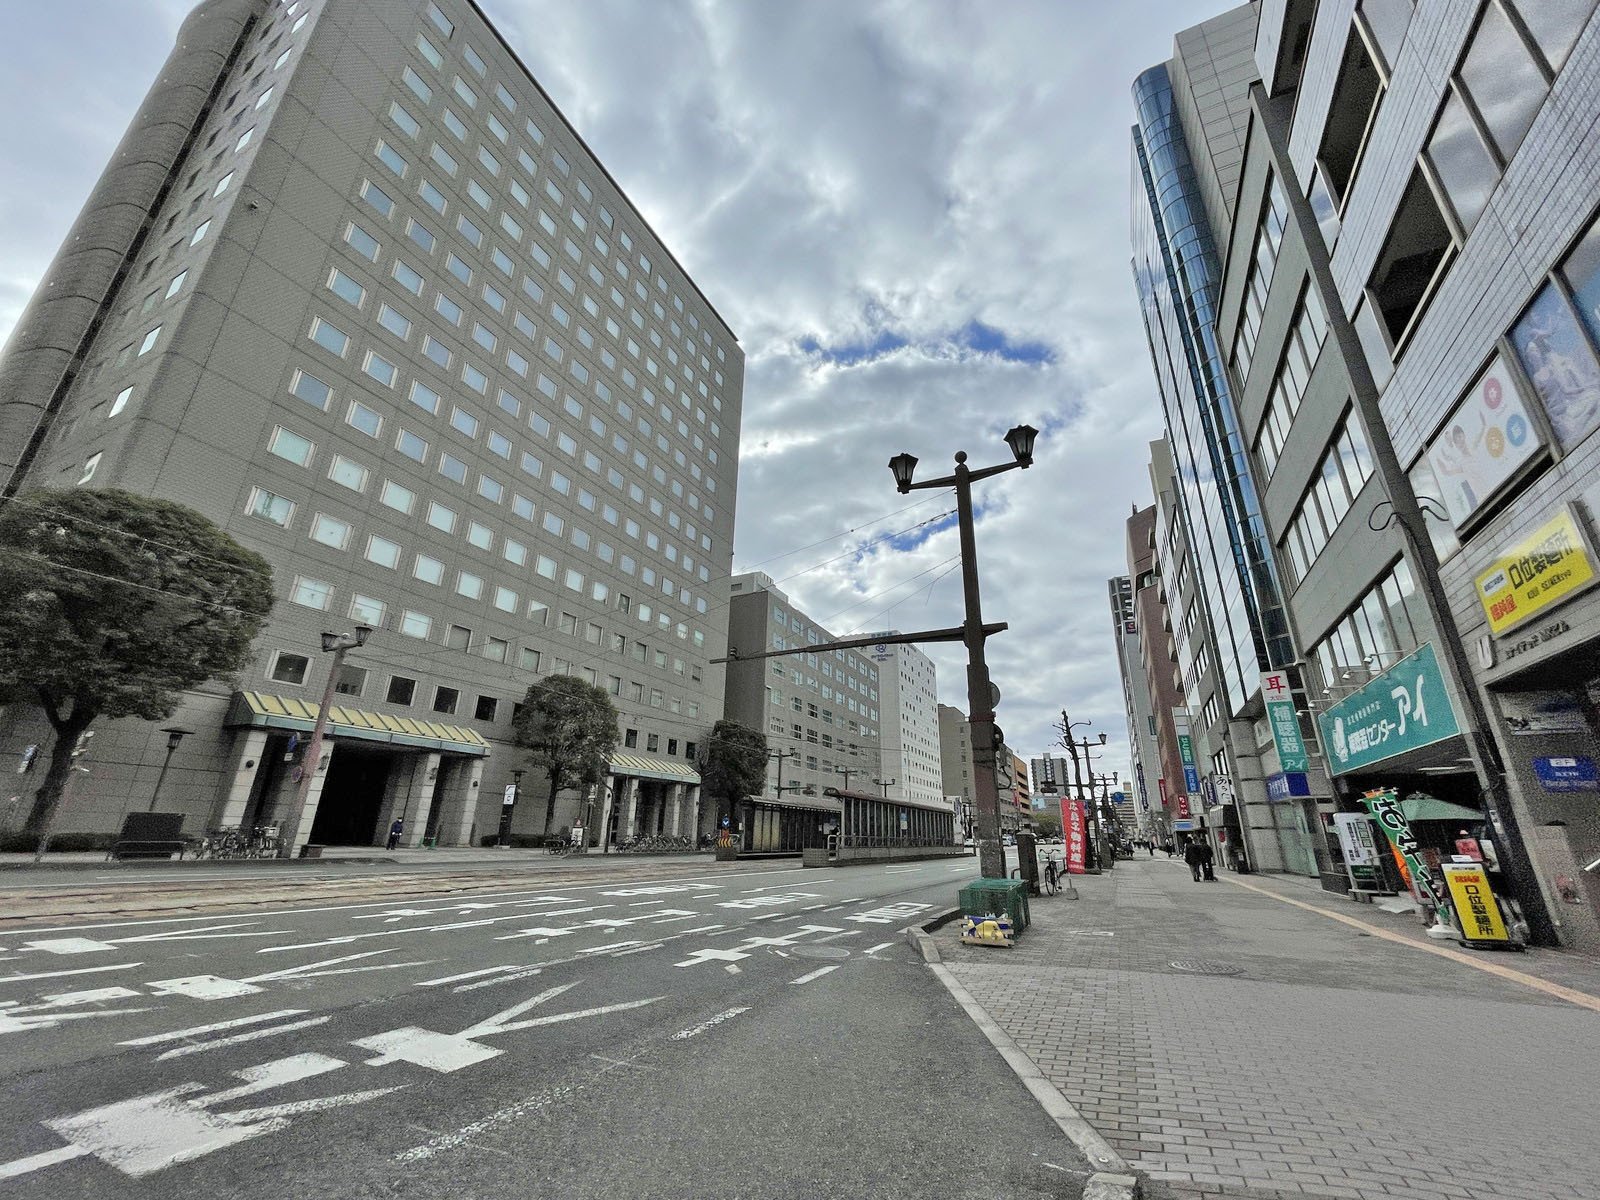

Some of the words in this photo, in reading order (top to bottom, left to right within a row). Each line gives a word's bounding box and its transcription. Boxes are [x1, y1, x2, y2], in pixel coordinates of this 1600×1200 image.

[1266, 675, 1286, 694] 耳
[1272, 705, 1299, 753] 補聴器
[1284, 758, 1305, 770] アイ
